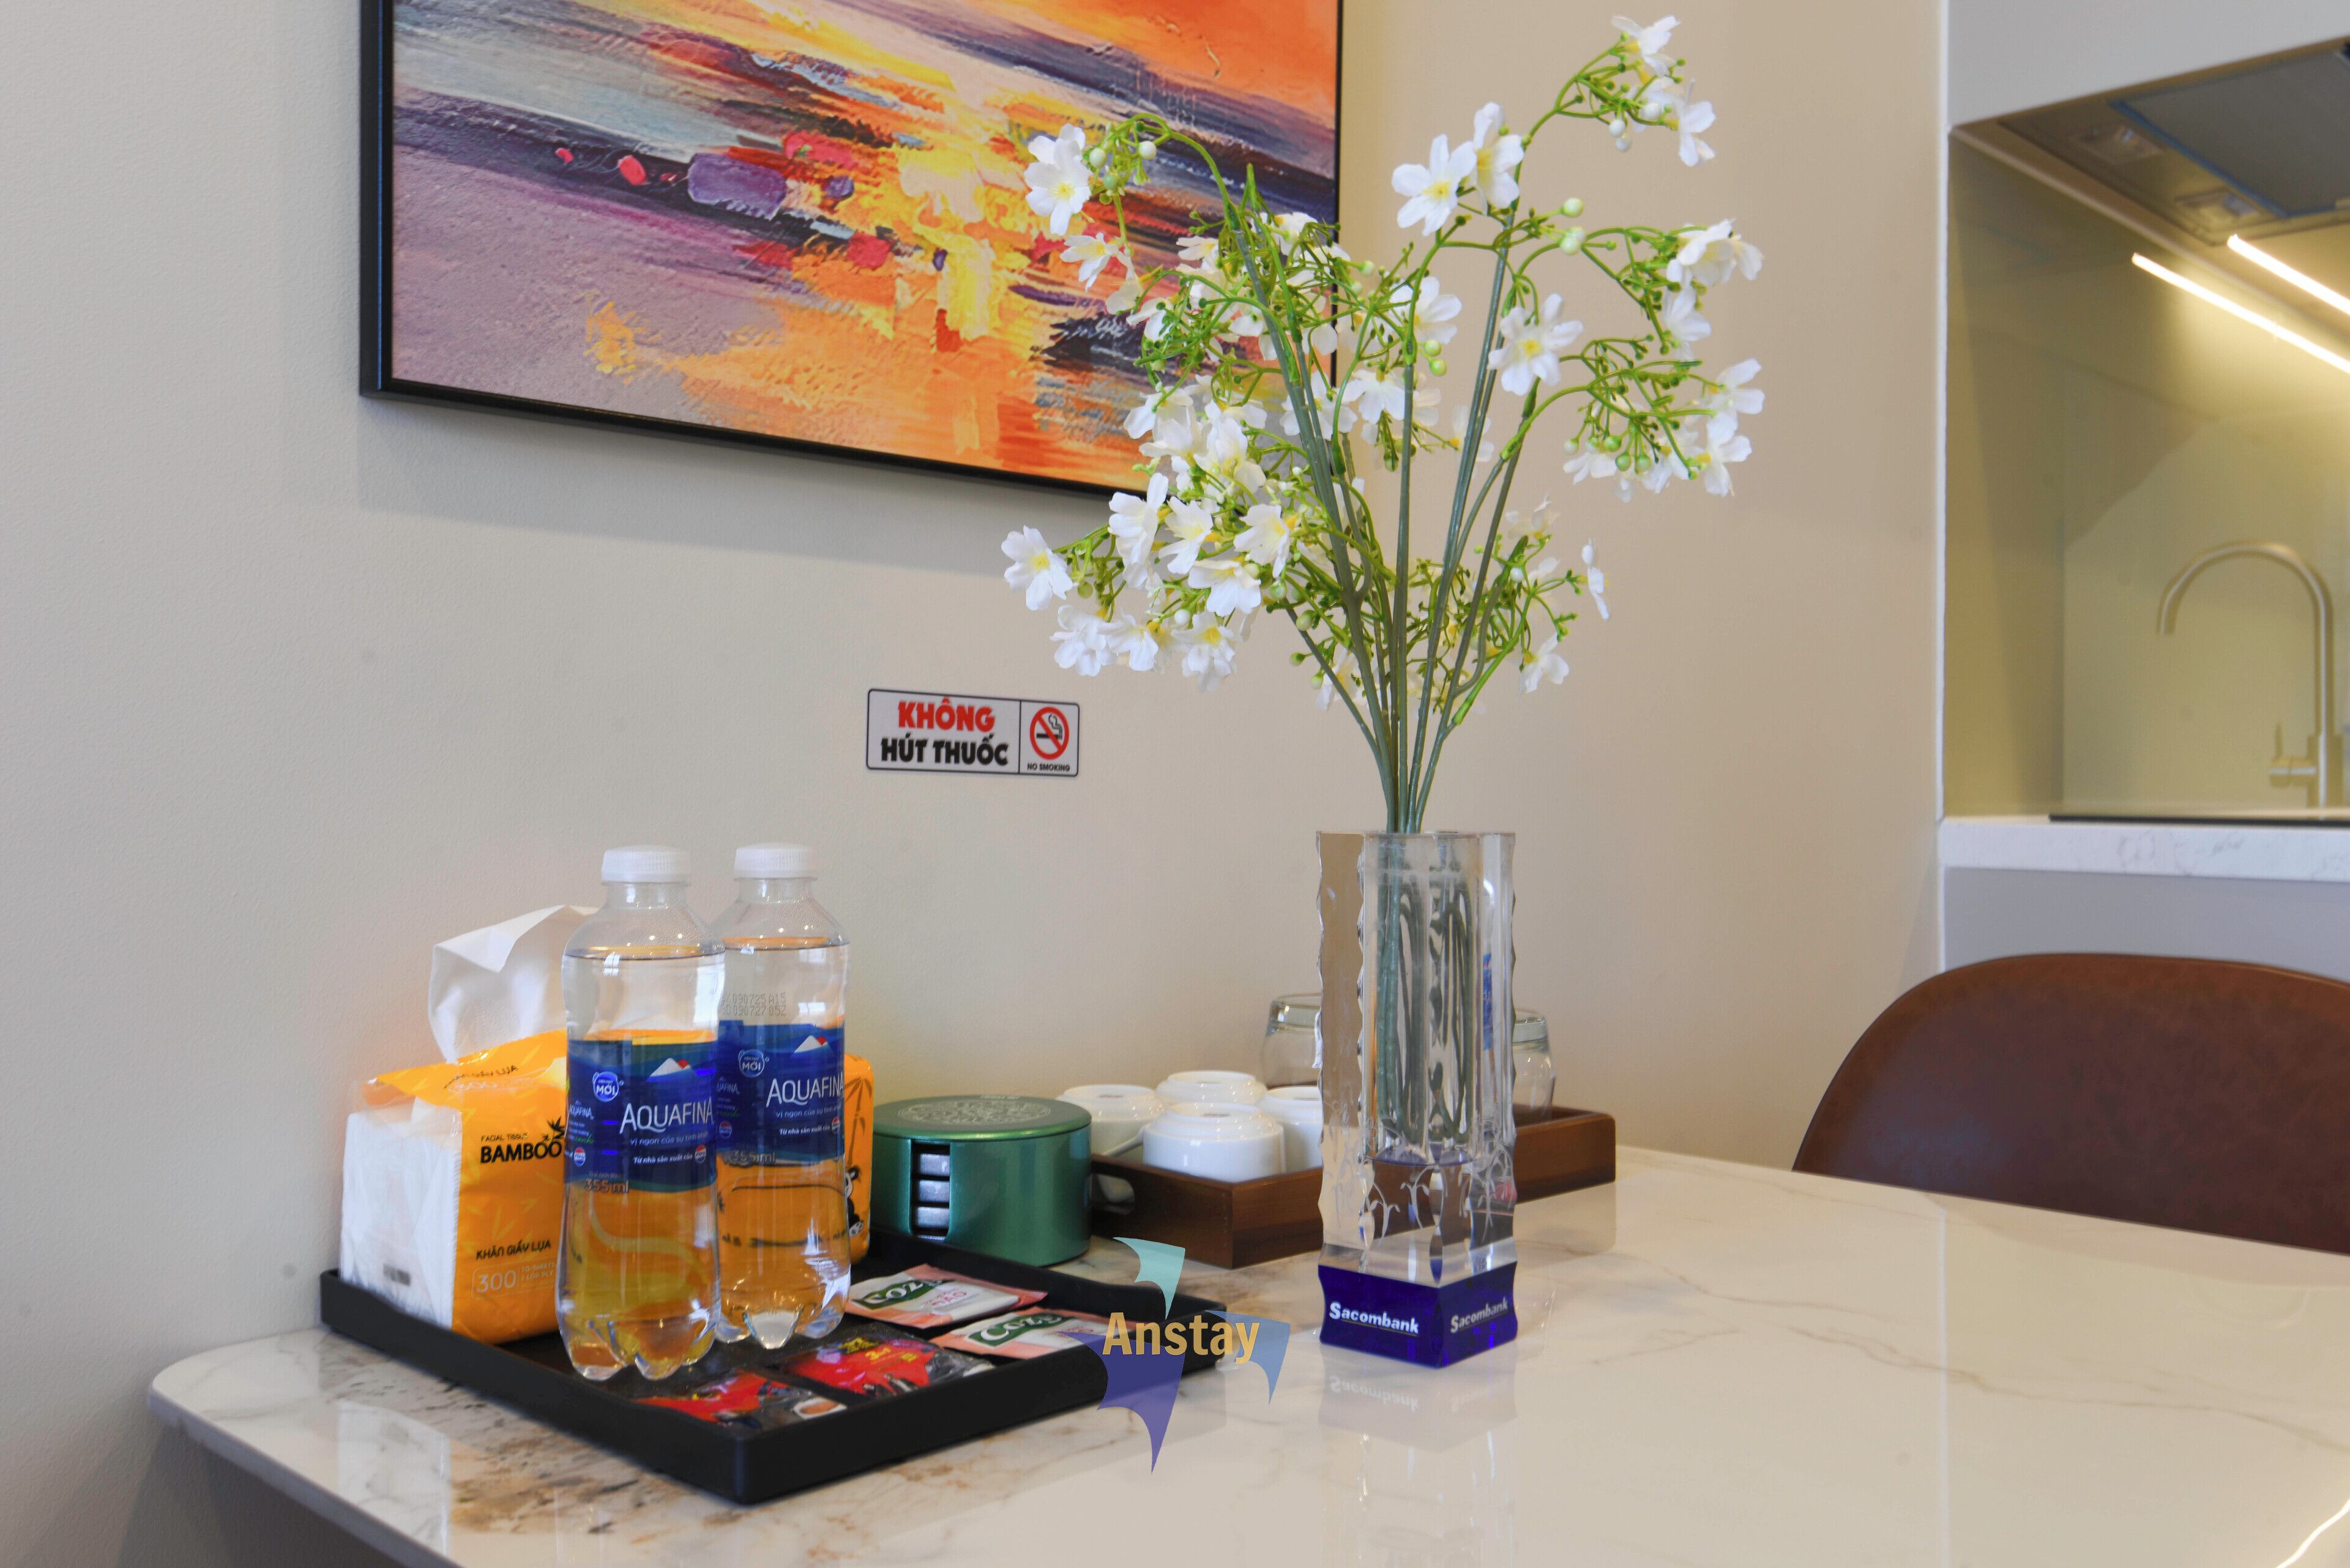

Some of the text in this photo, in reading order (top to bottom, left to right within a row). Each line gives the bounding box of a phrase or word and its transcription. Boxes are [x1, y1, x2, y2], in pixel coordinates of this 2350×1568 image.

[898, 696, 995, 733] KHÔNG
[881, 733, 1009, 766] HÚT THUỐC
[1039, 763, 1070, 772] SMOKING
[766, 1071, 844, 1108] AQUAFINA
[619, 1096, 715, 1134] AQUAFINA
[480, 1141, 562, 1163] BAMBOO
[584, 1178, 630, 1193] 355 ml
[476, 1269, 517, 1293] 300
[1329, 1302, 1419, 1334] Sacombank
[1450, 1297, 1508, 1333] Sacombank
